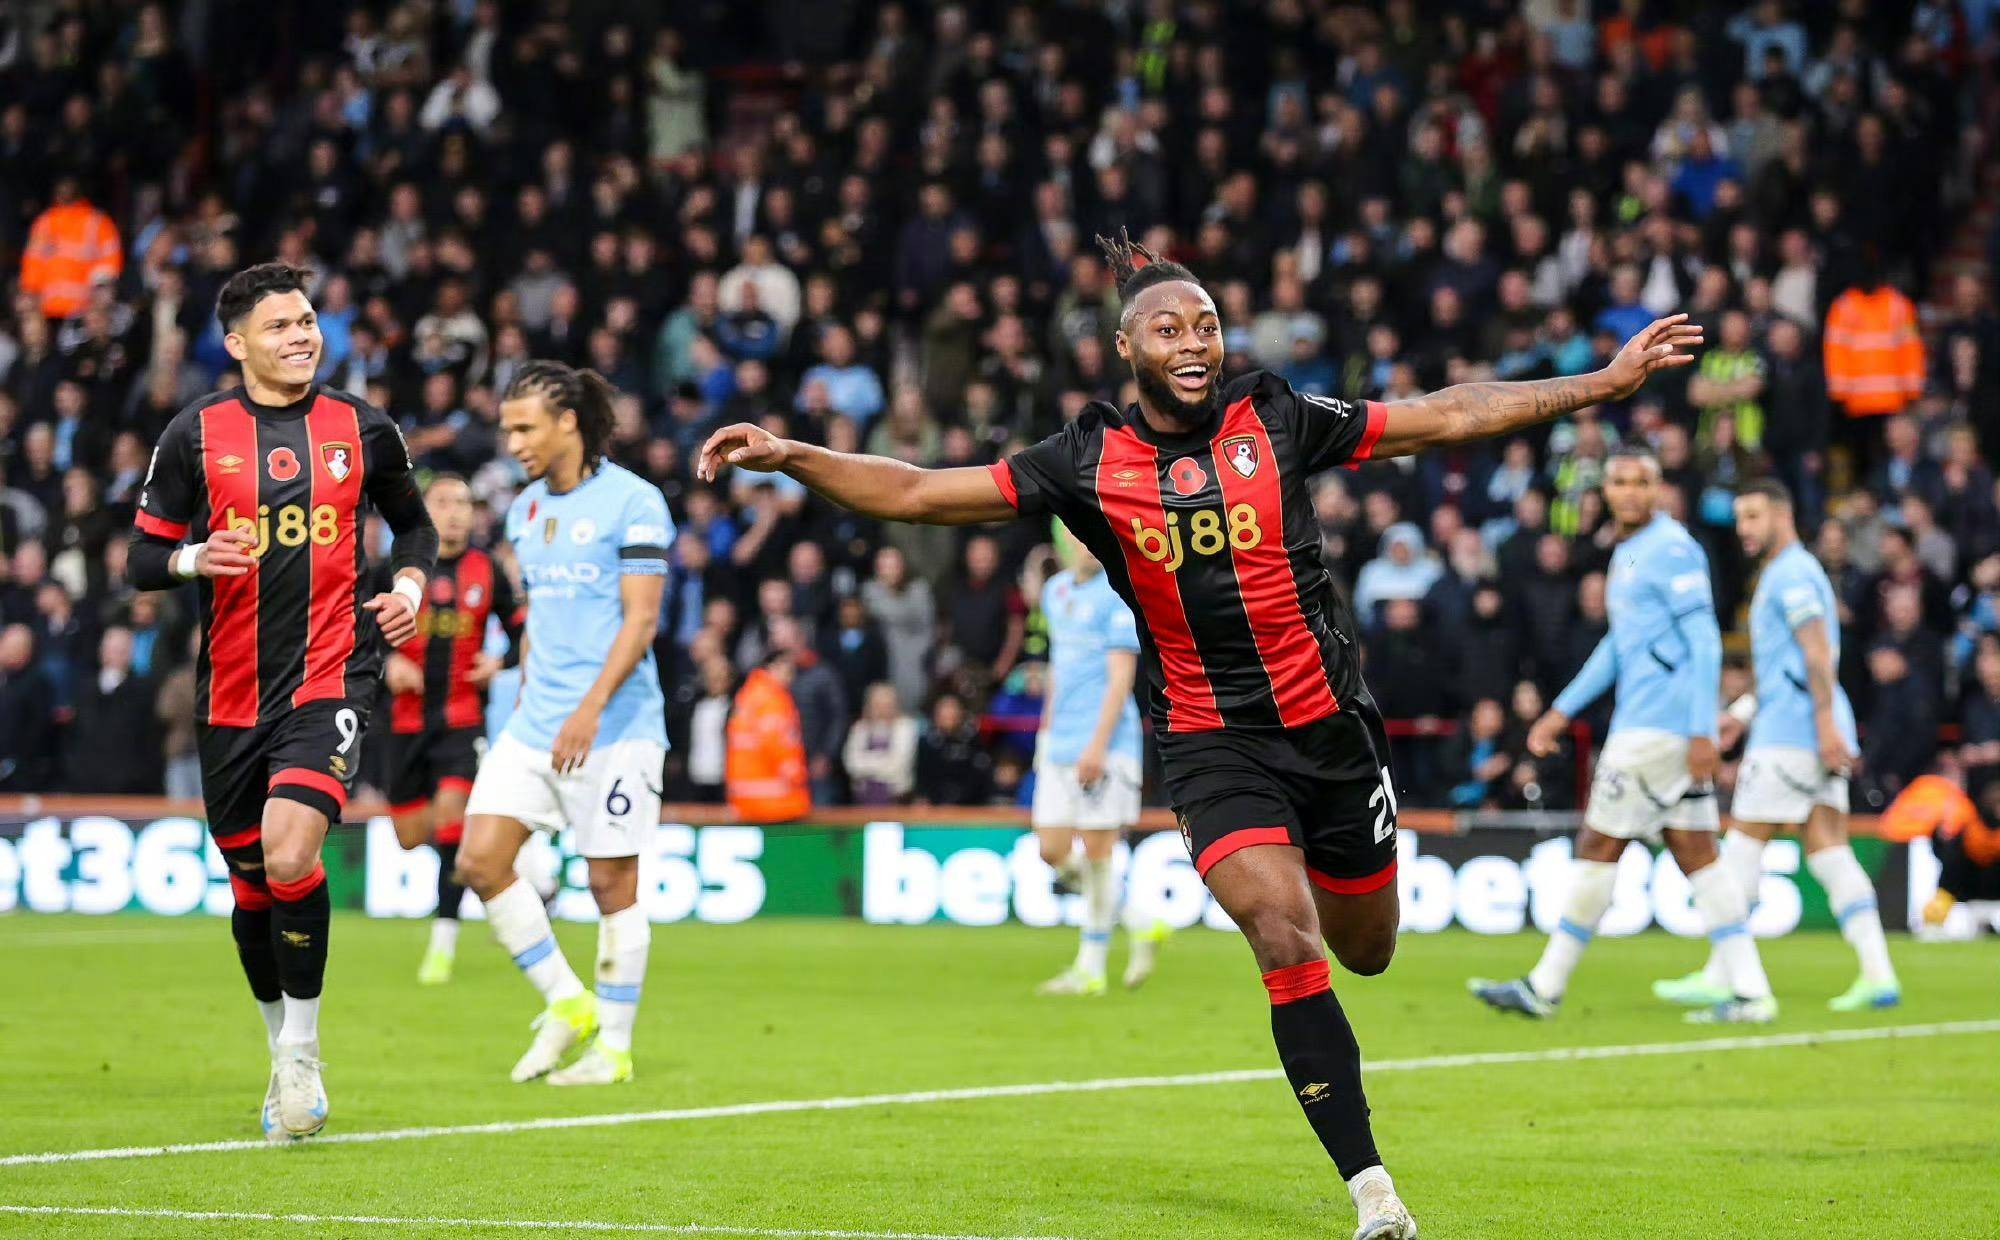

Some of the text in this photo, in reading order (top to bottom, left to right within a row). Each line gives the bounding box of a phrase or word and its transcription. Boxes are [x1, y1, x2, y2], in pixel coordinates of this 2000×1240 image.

[226, 504, 339, 558] bj88
[1130, 503, 1262, 573] bj88
[335, 708, 358, 754] 9
[606, 777, 631, 816] 6
[0, 816, 233, 917] t36
[366, 815, 766, 923] b365
